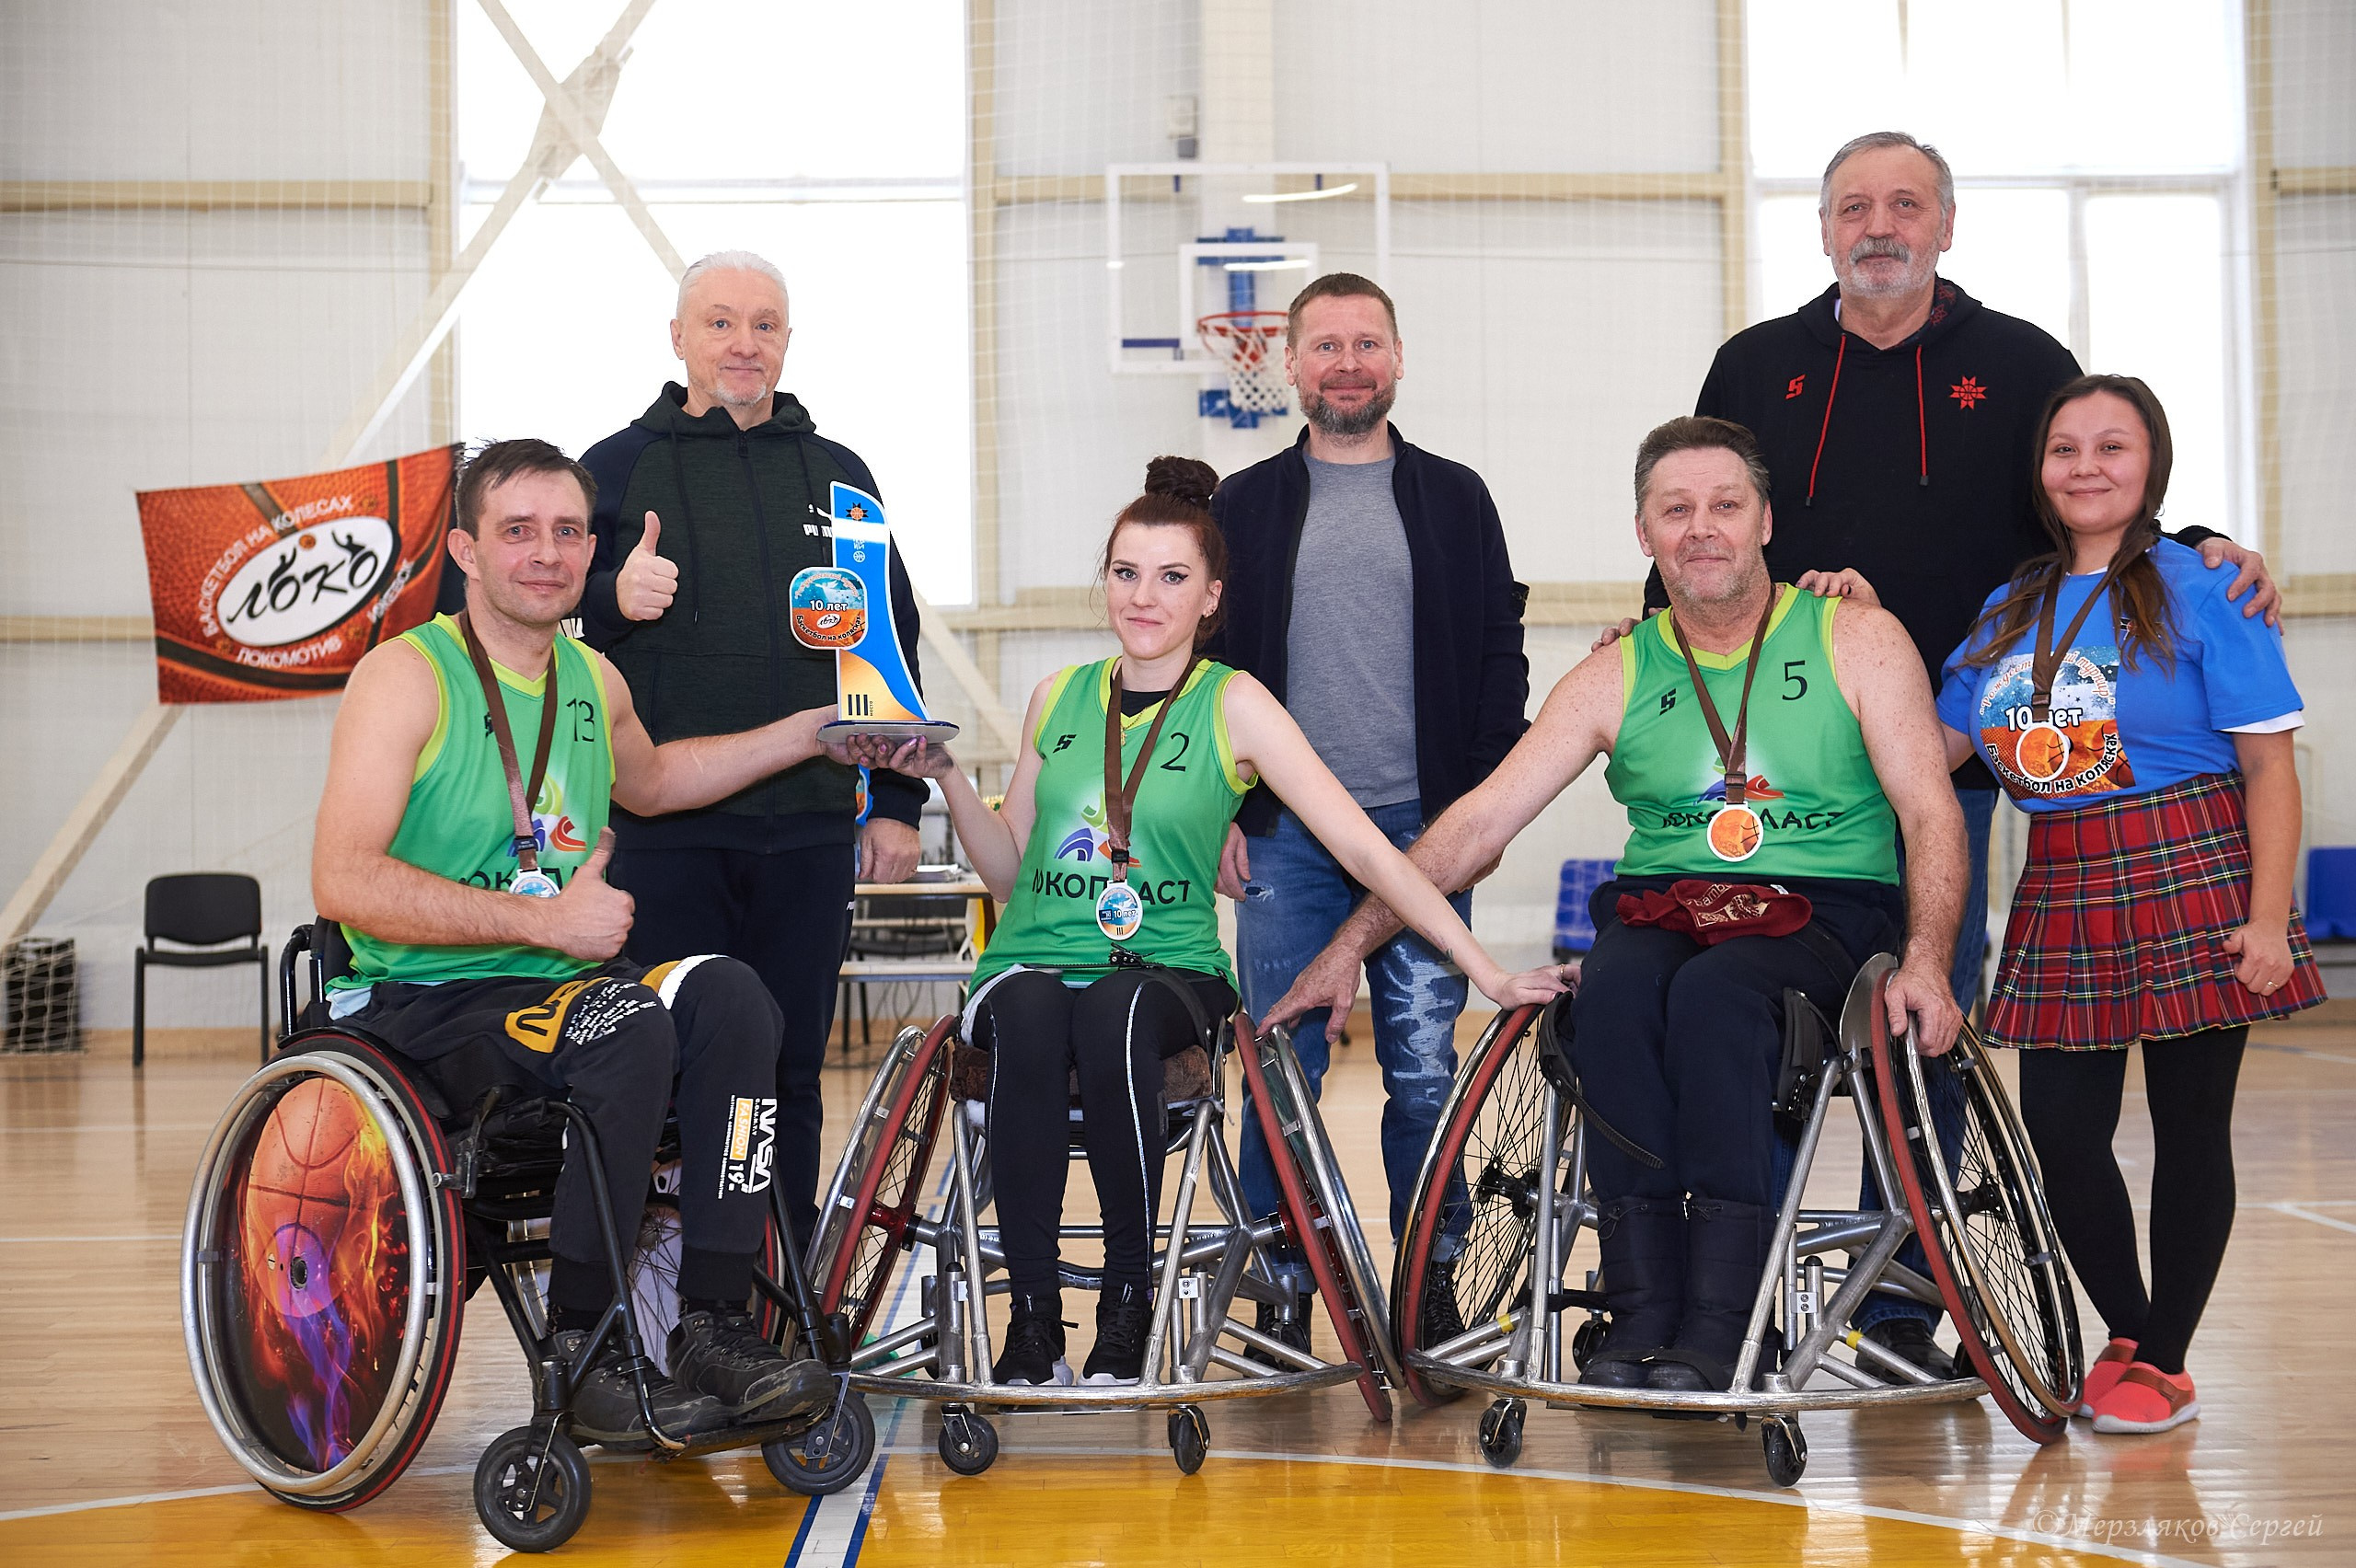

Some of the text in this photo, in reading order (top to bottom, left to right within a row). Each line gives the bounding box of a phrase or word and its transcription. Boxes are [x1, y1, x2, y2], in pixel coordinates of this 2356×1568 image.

[803, 523, 833, 538] PUM
[197, 494, 355, 638] БАСКЕТБОЛ НА КОЛЕСАХ
[810, 599, 848, 612] 10 лет
[796, 615, 826, 640] Баскетбол
[837, 616, 861, 640] колясках
[237, 634, 343, 669] ЛОКОМОТИВ
[1782, 660, 1808, 701] 5
[566, 698, 595, 743] 13
[2004, 706, 2033, 732] 10
[1160, 732, 1190, 772] 2
[1985, 733, 2118, 794] Баскетбол на колясках
[1114, 910, 1122, 918] 10
[733, 1101, 750, 1157] FASHION
[746, 1098, 778, 1193] NASA
